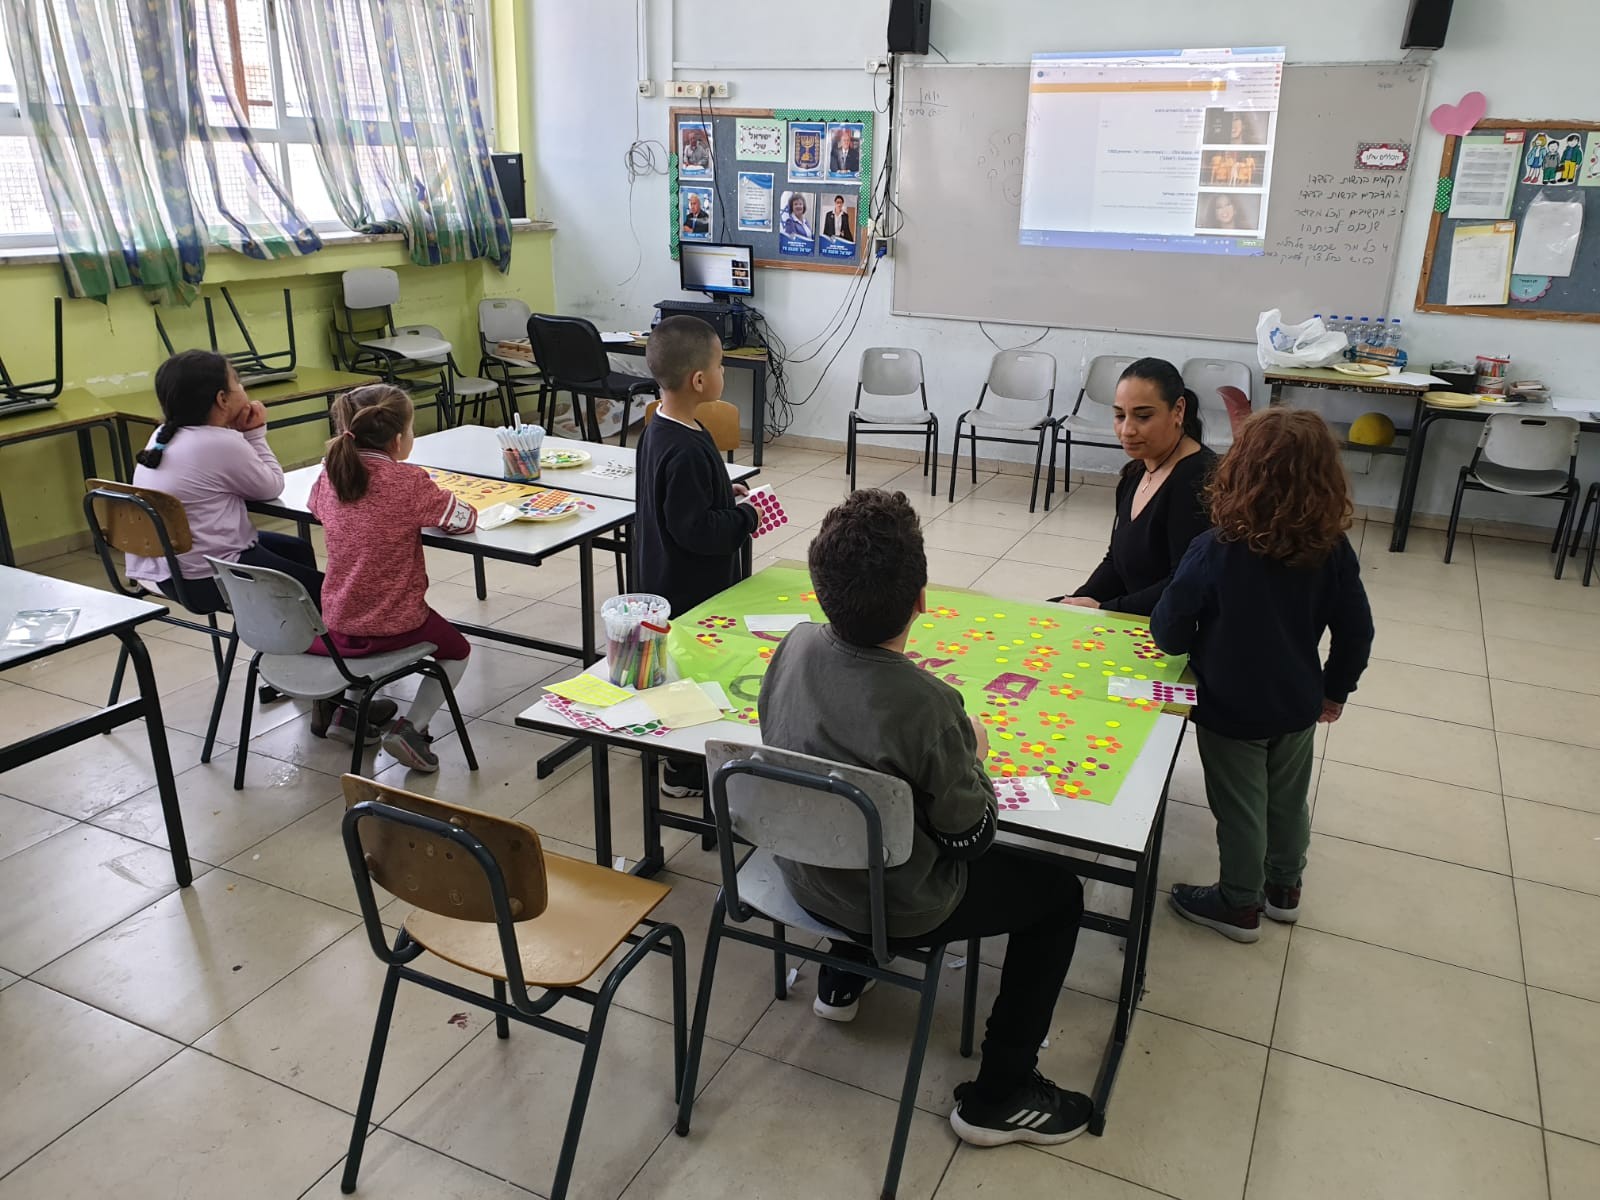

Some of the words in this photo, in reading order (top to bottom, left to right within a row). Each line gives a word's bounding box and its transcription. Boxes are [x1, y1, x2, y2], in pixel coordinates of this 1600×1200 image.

[748, 131, 771, 140] ישראל
[1339, 175, 1370, 185] ברשות
[1372, 174, 1395, 188] קמים
[1327, 191, 1358, 200] ברשות
[1361, 190, 1391, 200] מדברים
[1347, 220, 1380, 234] שנכנס
[1344, 243, 1359, 251] מה
[1362, 238, 1376, 253] כל
[952, 839, 969, 848] AND
